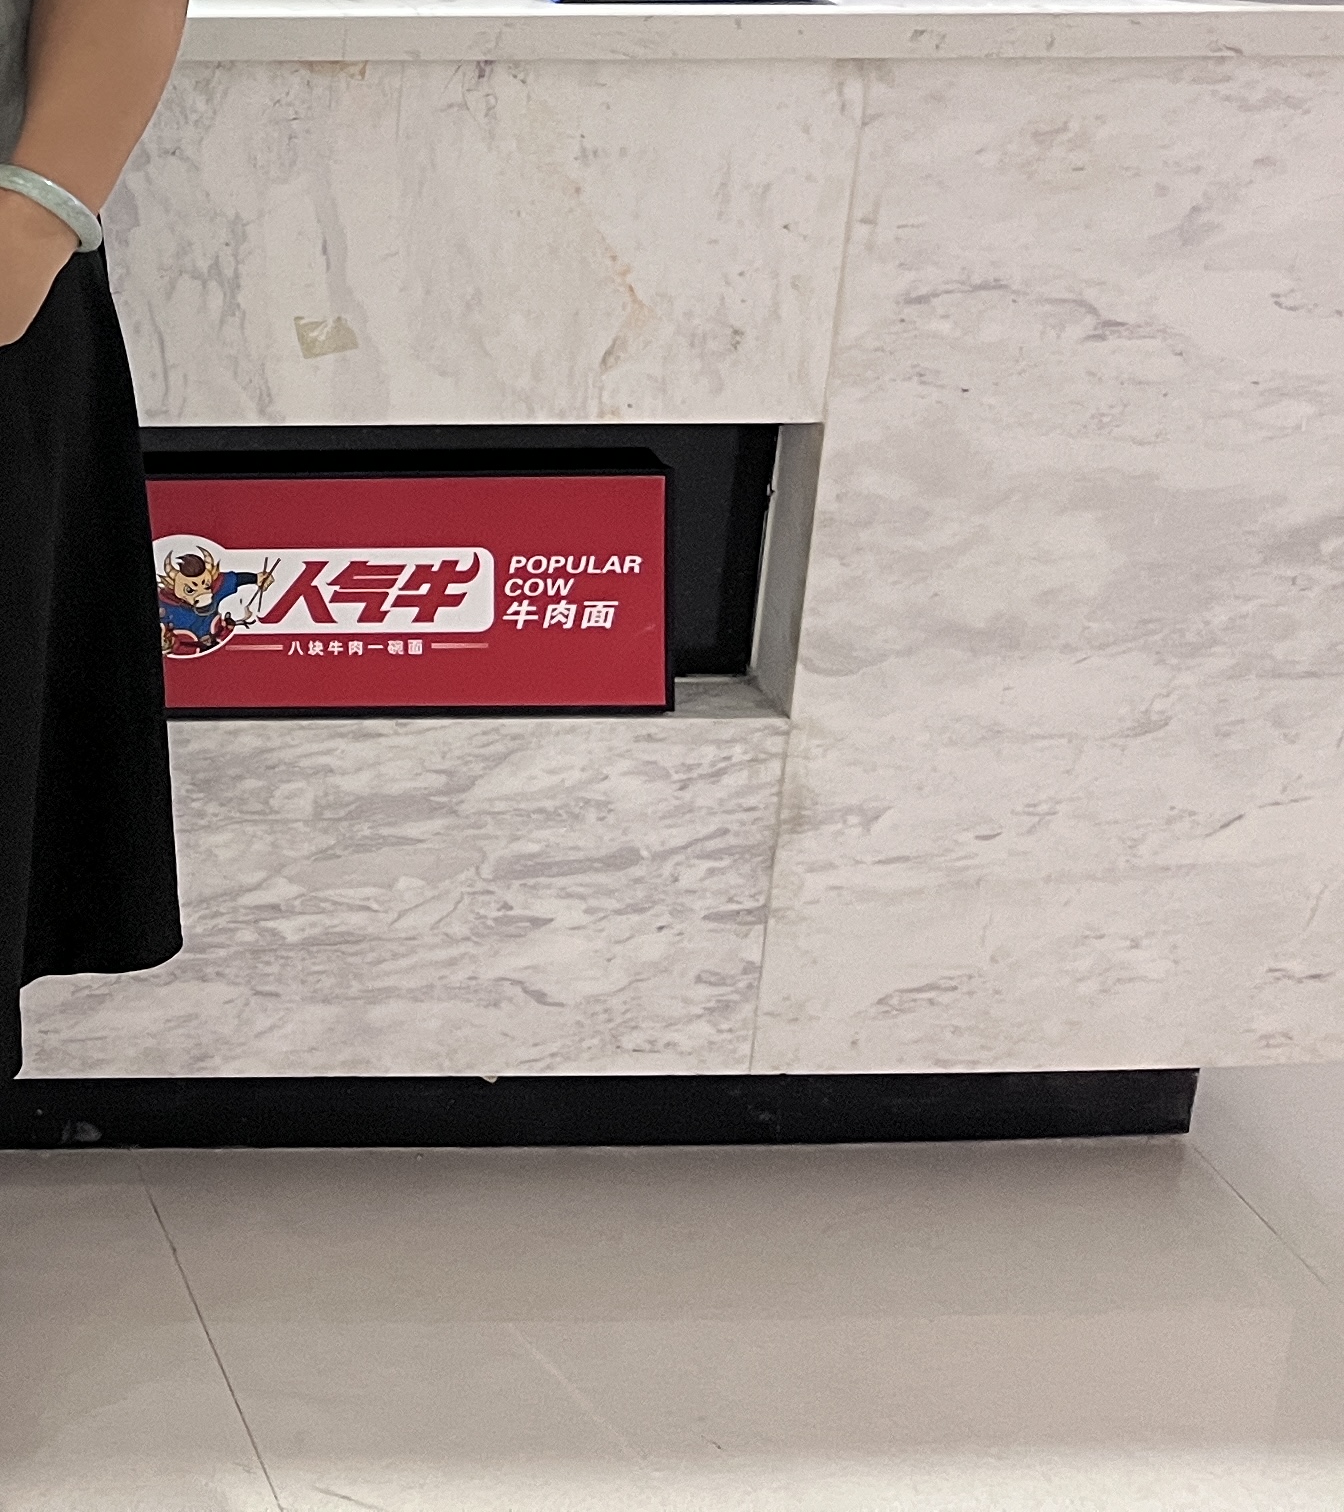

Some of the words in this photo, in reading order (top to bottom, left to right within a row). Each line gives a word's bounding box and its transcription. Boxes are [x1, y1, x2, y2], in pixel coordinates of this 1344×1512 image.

[508, 555, 642, 575] POPULAR
[257, 552, 481, 624] 人气牛
[504, 578, 575, 597] COW
[502, 599, 620, 630] 牛肉面
[287, 639, 424, 656] 八块牛肉一碗面
